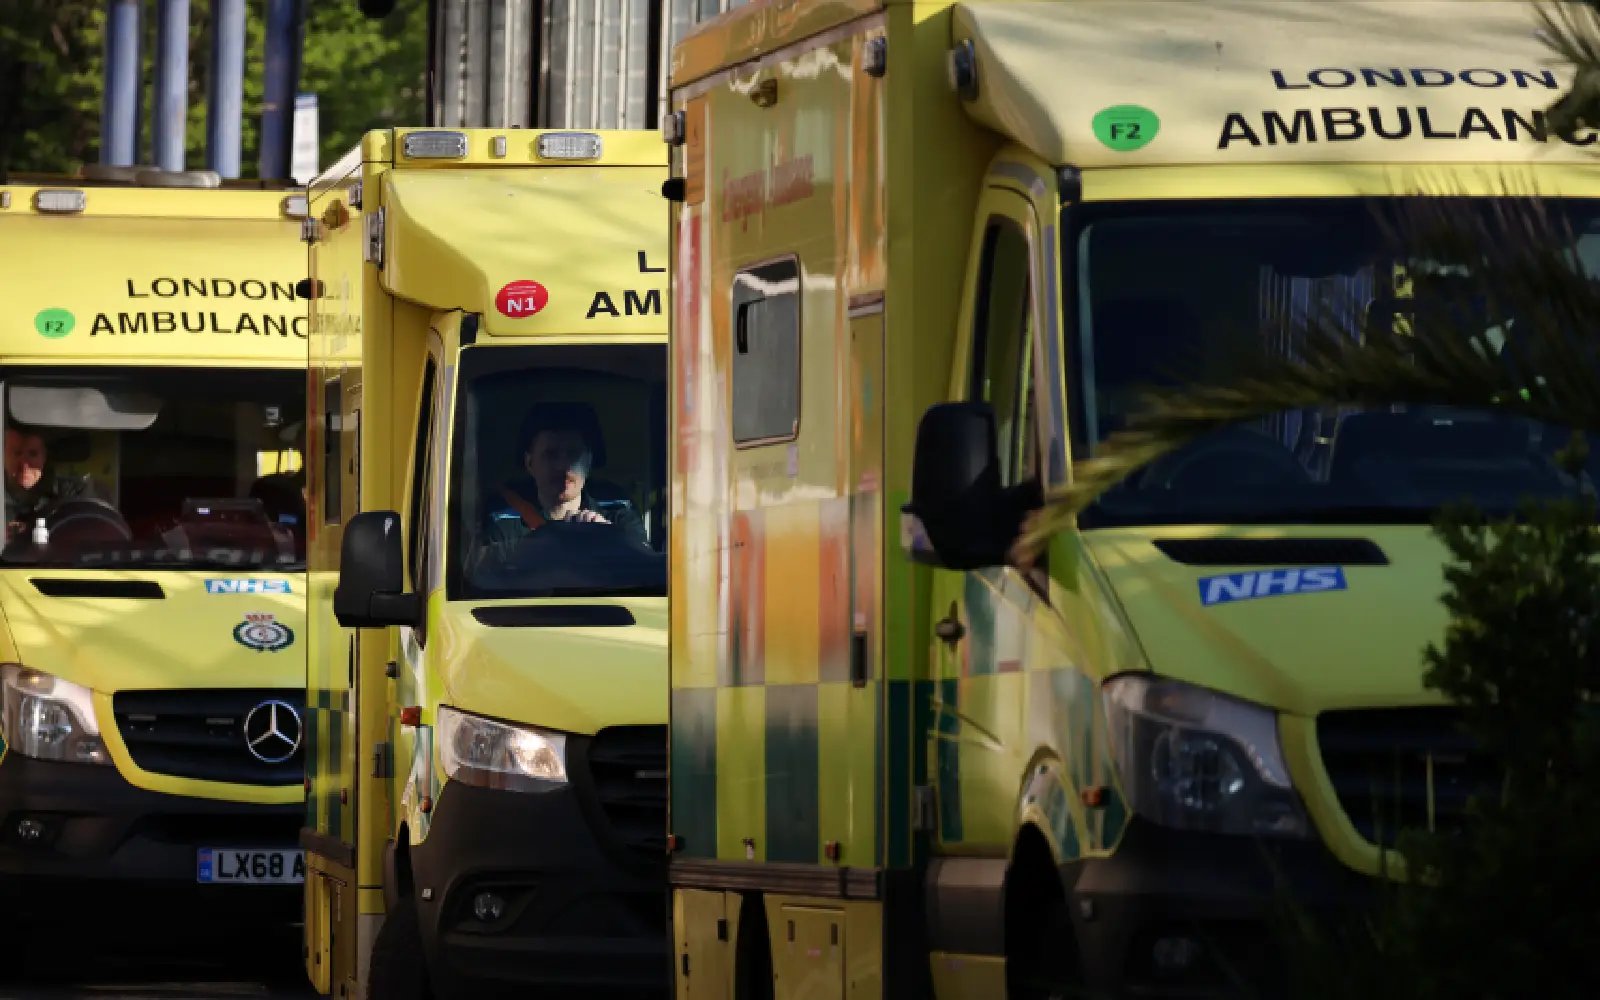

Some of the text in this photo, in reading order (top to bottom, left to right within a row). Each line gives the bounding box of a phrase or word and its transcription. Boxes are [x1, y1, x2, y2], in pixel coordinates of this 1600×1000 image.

[1269, 67, 1559, 90] LONDON
[1110, 122, 1142, 140] F2
[126, 277, 296, 301] LONDON
[507, 297, 536, 312] N1
[210, 579, 287, 593] NHS
[1206, 566, 1338, 603] NHS
[217, 851, 284, 878] LX68
